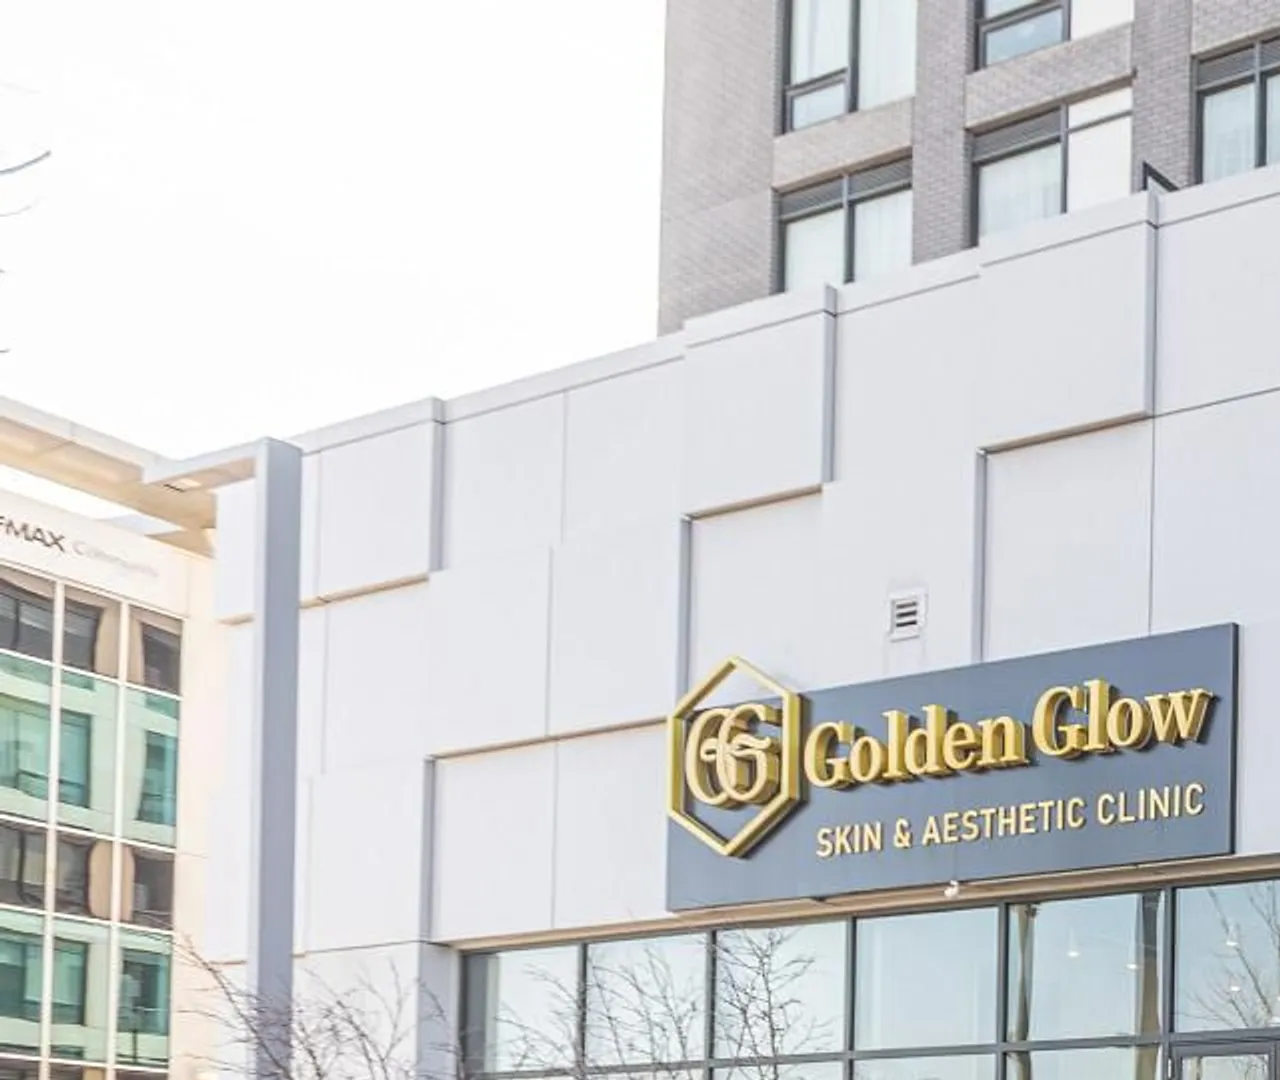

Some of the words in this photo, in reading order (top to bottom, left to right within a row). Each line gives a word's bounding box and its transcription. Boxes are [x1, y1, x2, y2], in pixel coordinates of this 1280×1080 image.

[0, 516, 65, 553] MAX
[804, 703, 1029, 790] Golden
[1032, 678, 1214, 758] Glow
[815, 821, 883, 858] SKIN
[893, 817, 912, 849] &
[921, 796, 1086, 846] AESTHETIC
[1096, 782, 1205, 825] CLINIC
